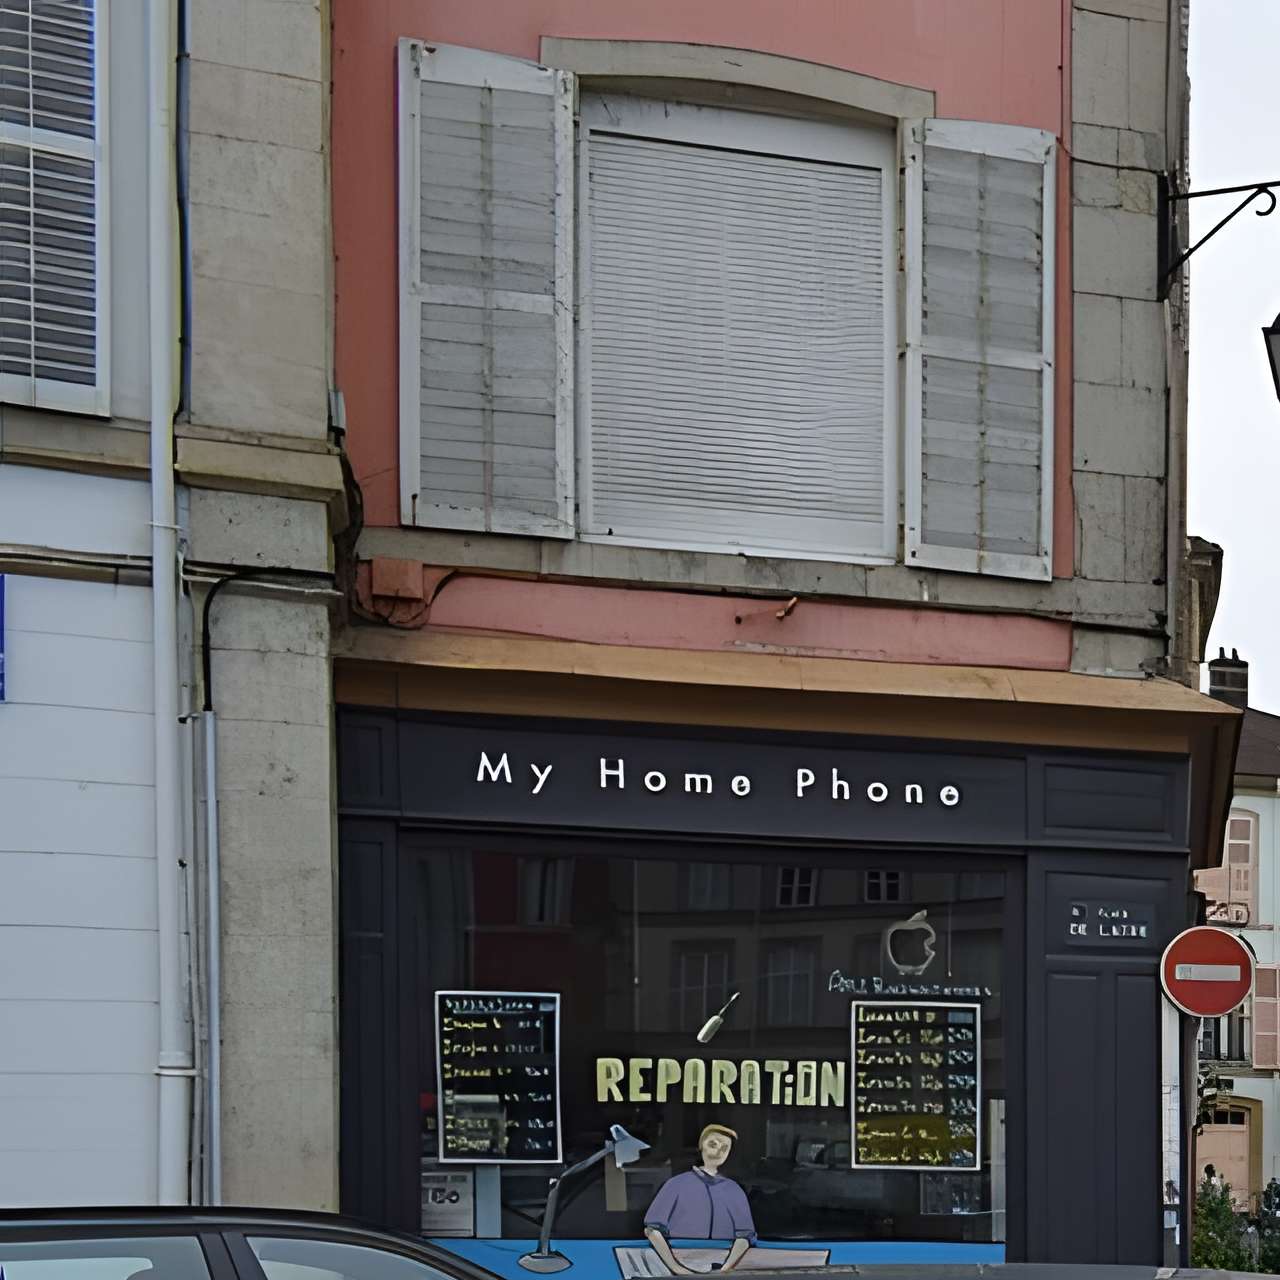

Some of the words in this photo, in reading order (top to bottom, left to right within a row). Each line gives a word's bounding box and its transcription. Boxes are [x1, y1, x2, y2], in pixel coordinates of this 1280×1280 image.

[476, 751, 553, 795] My
[599, 757, 752, 797] Home
[796, 767, 961, 806] Phone
